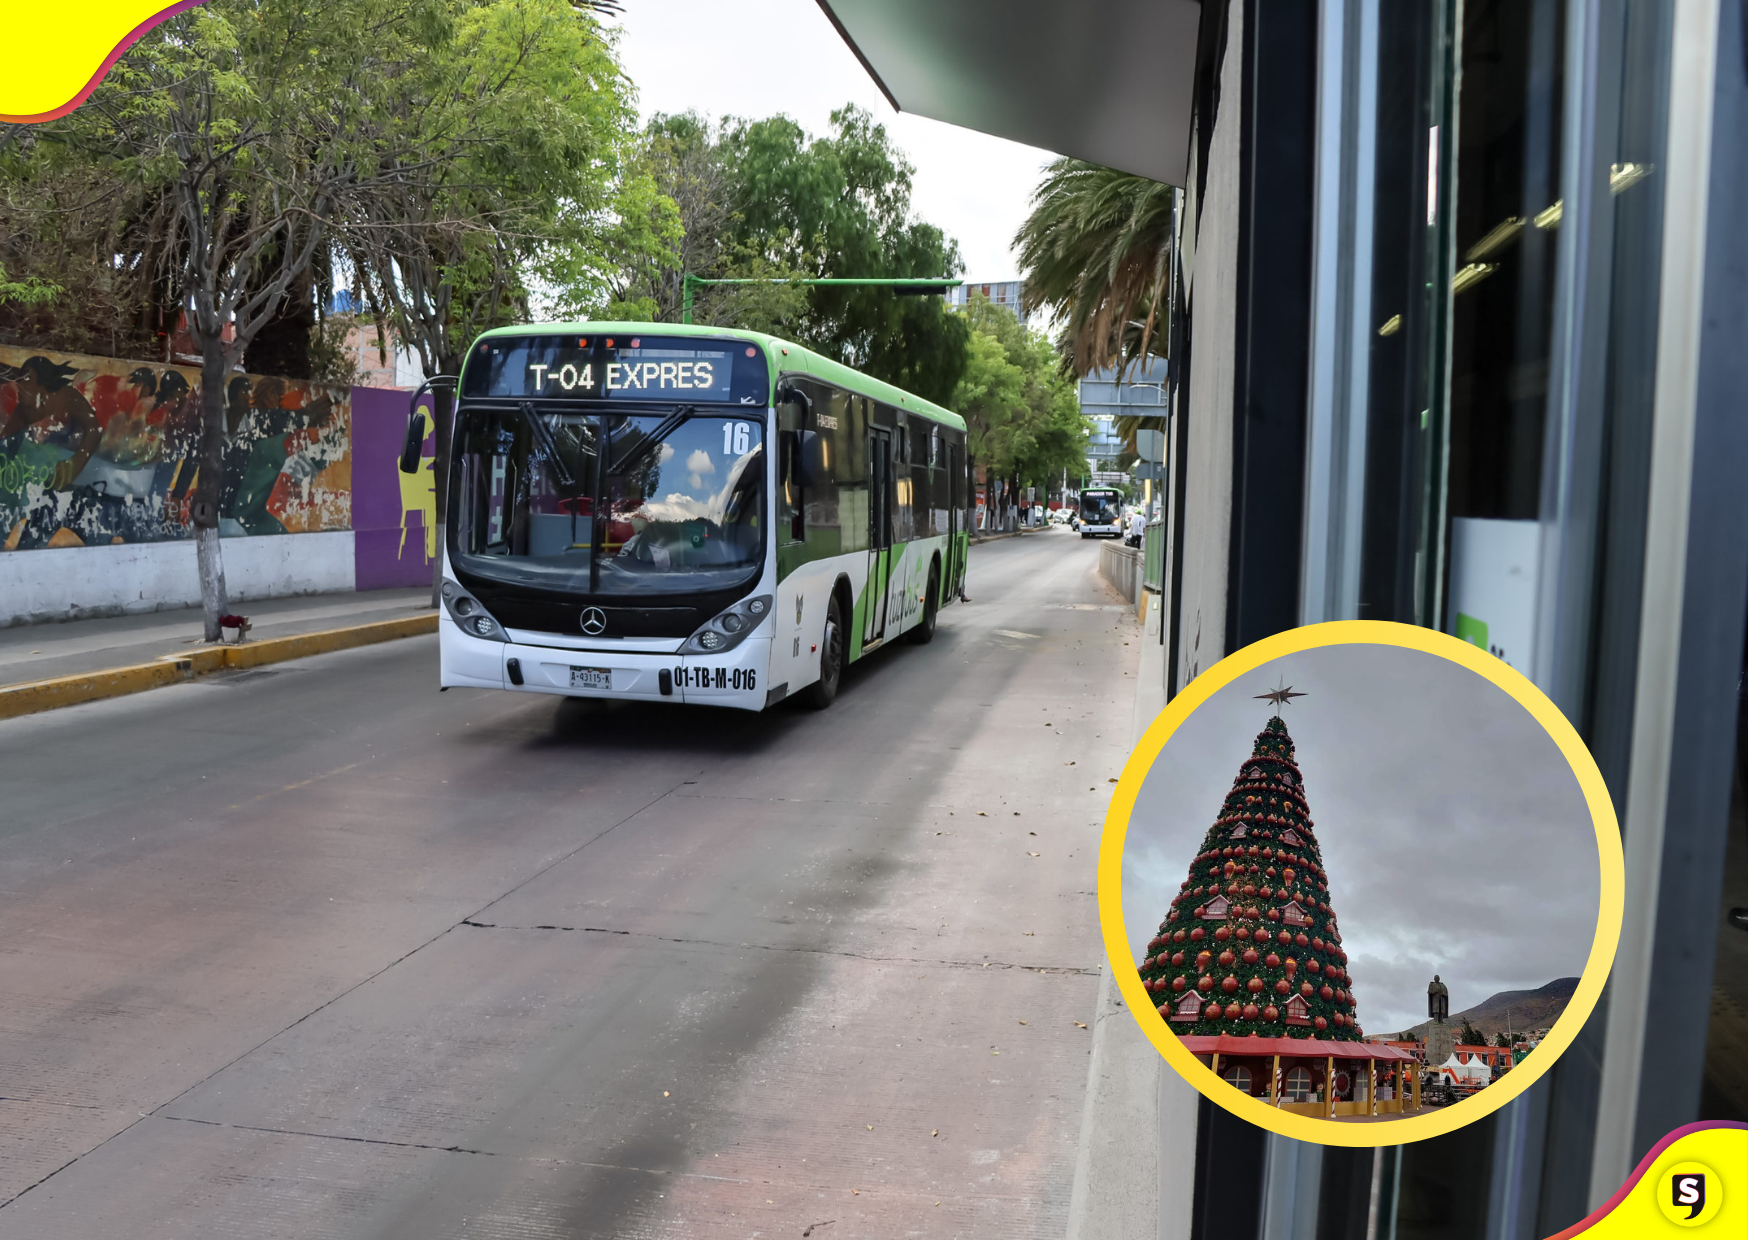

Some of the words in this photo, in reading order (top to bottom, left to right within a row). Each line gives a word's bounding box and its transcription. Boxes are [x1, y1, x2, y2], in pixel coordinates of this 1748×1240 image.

[529, 363, 595, 391] T-04
[606, 361, 713, 390] EXPRES
[722, 422, 750, 455] 16
[571, 671, 610, 684] A-43115-K
[674, 665, 756, 691] 01-TB-M-016
